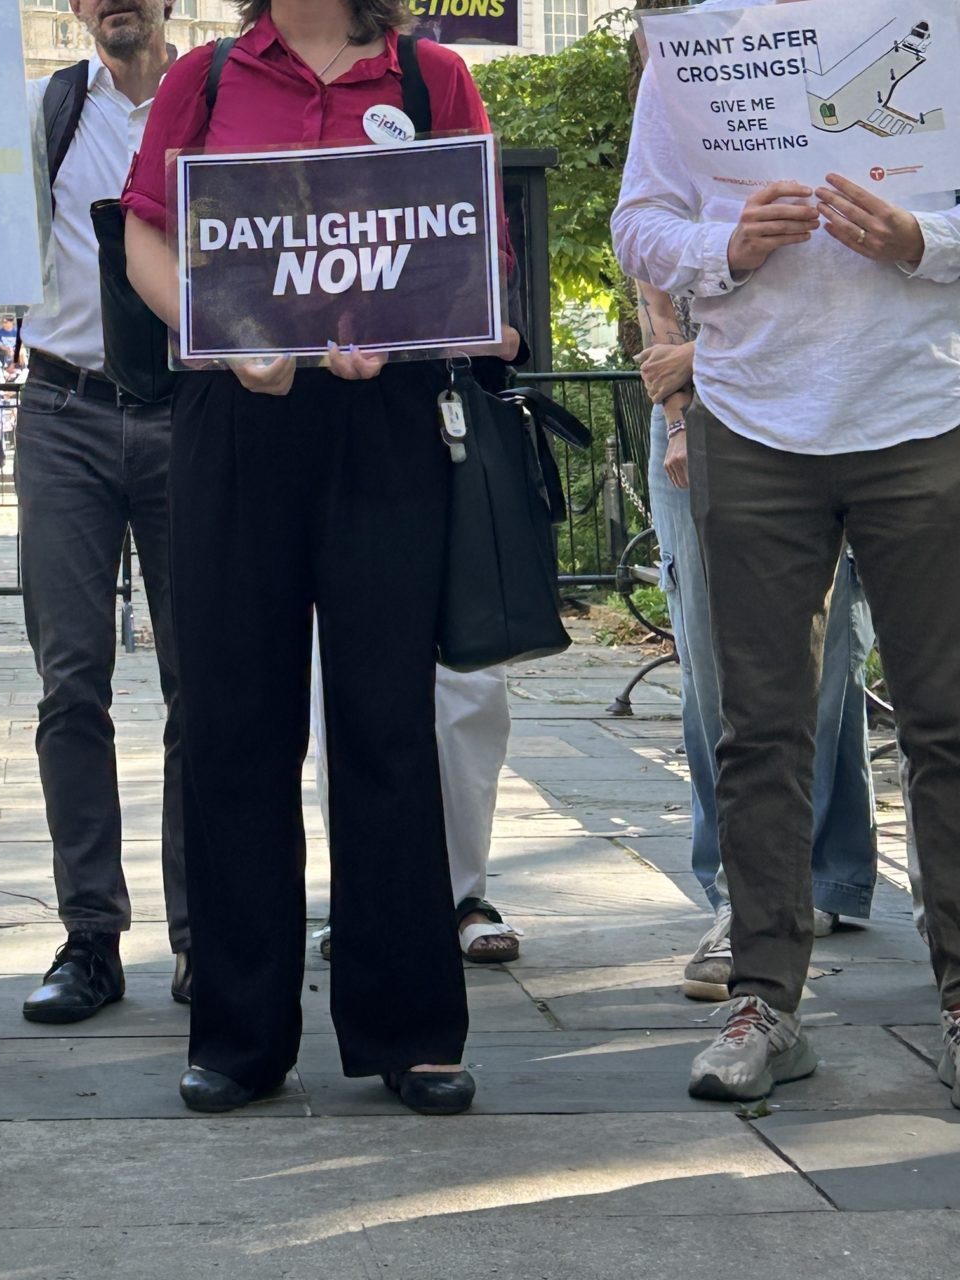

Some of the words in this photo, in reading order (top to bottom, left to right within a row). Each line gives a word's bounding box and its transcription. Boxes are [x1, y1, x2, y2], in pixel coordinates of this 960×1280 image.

[659, 40, 666, 58] I
[669, 37, 735, 57] WANT
[743, 28, 817, 52] SAFER
[677, 57, 807, 83] CROSSINGS!
[710, 99, 747, 113] GIVE
[751, 97, 775, 111] ME
[727, 118, 768, 133] SAFE
[702, 134, 809, 152] DAYLIGHTING
[199, 202, 476, 251] DAYLIGHTING
[272, 244, 411, 296] NOW
